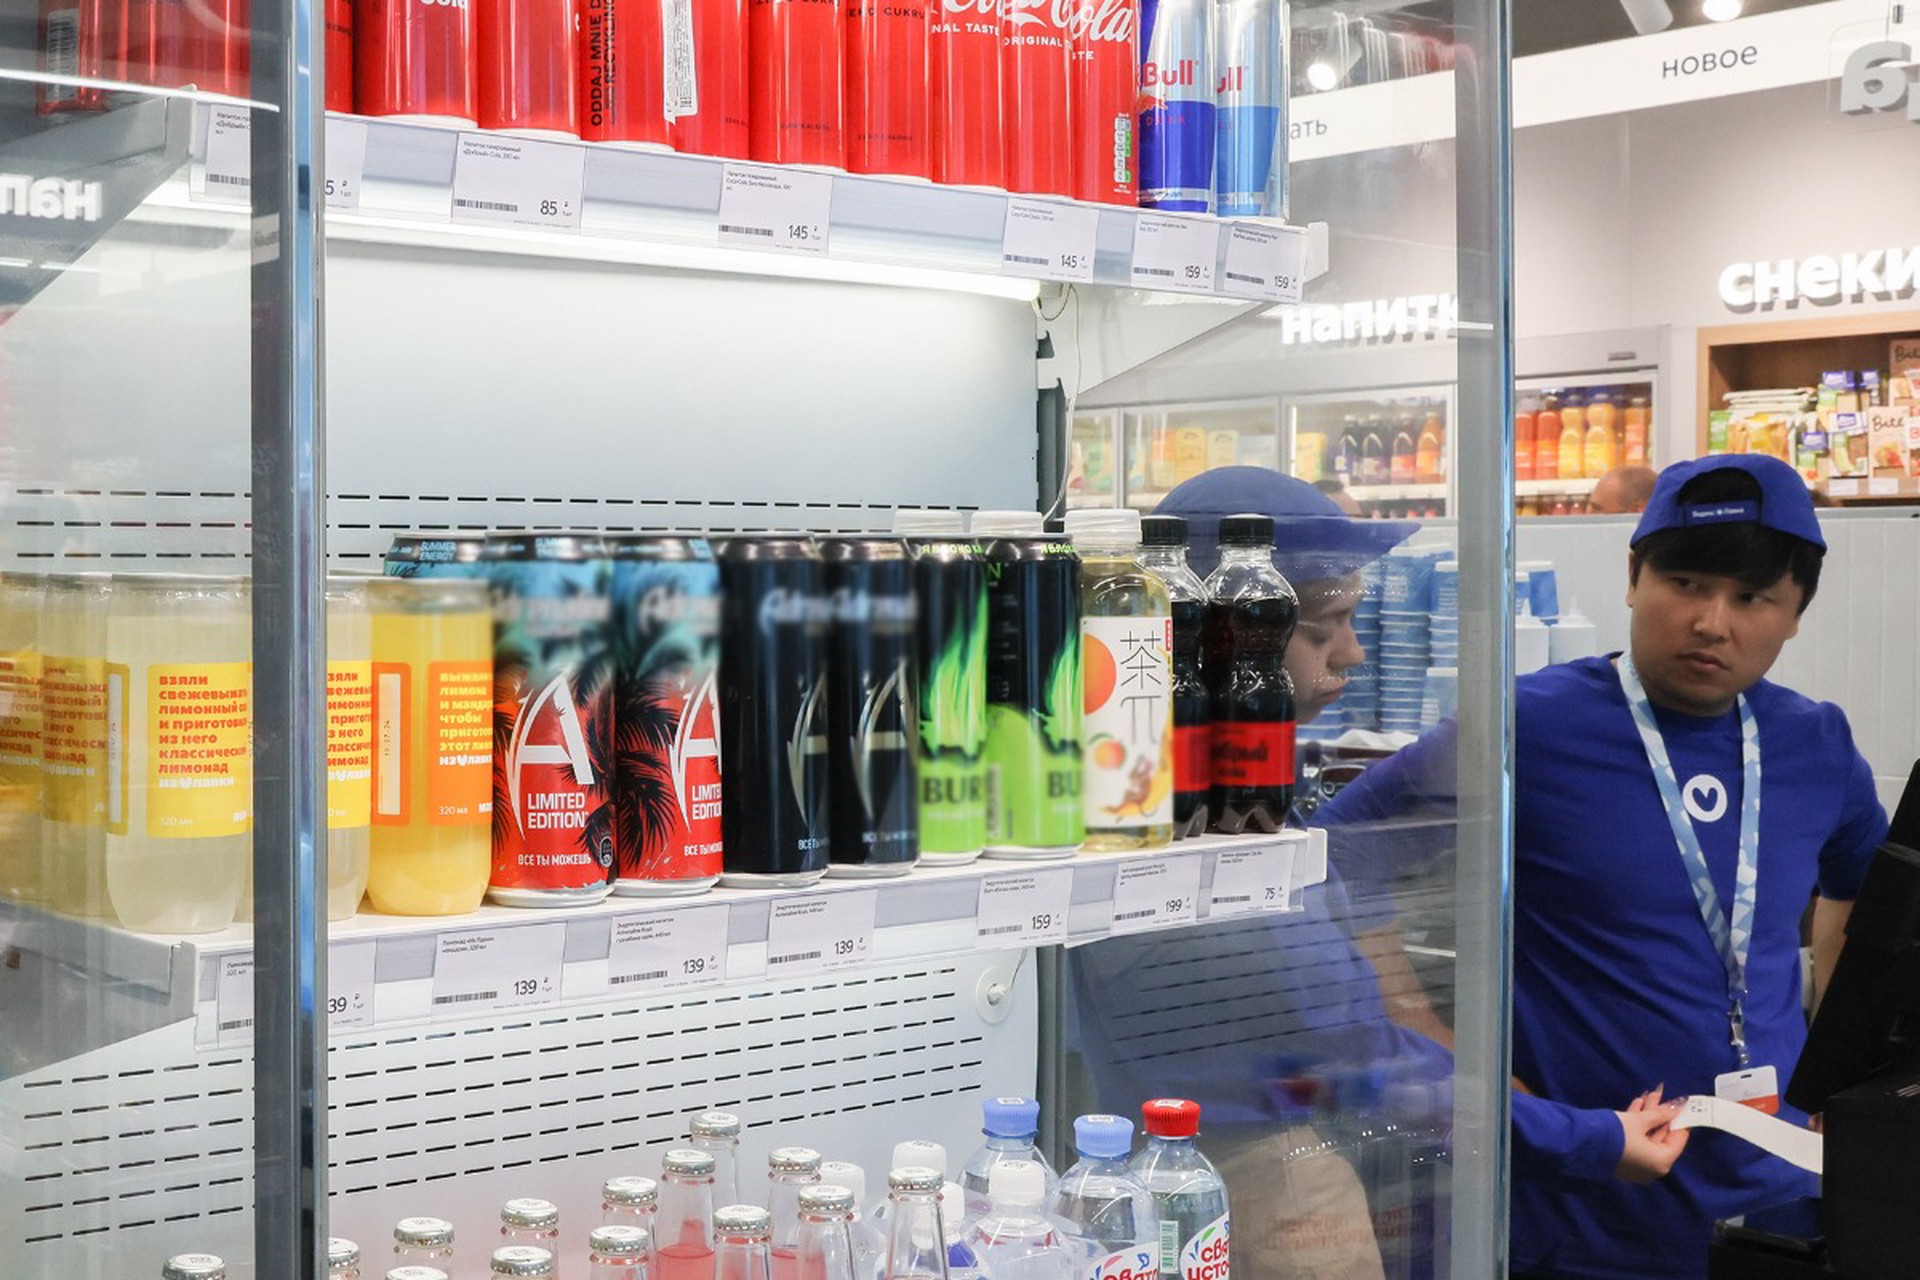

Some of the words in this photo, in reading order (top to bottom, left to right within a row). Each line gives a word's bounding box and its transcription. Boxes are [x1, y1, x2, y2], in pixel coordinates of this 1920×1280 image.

[591, 15, 602, 60] MNIE
[1662, 45, 1758, 79] новое
[591, 66, 602, 126] ODDAJ
[1289, 119, 1328, 140] ать
[324, 180, 335, 195] 5
[540, 200, 557, 215] 85
[788, 225, 808, 239] 145
[1061, 254, 1077, 268] 145
[1185, 265, 1200, 279] 159
[1718, 245, 1920, 306] снеки
[1274, 275, 1289, 289] 159
[159, 676, 208, 686] взяли
[326, 672, 358, 682] зяли
[158, 701, 237, 714] лимонный
[440, 701, 449, 710] и
[159, 720, 169, 729] и
[440, 713, 482, 723] чтобы
[159, 735, 178, 744] из
[182, 734, 217, 744] него
[327, 728, 336, 738] з
[338, 727, 364, 738] него
[439, 742, 471, 751] этот
[158, 763, 229, 774] лимонад
[326, 756, 369, 767] имонад
[692, 783, 722, 801] LIMITE
[528, 793, 585, 810] LIMITED
[439, 807, 455, 816] 320
[692, 801, 722, 820] EDITIO
[528, 811, 585, 829] EDITION
[684, 845, 698, 856] ВСЕ
[518, 854, 534, 865] ВСЕ
[537, 854, 550, 865] ТЫ
[552, 853, 592, 865] МОЖЕШЬ
[1265, 888, 1275, 900] 75
[1165, 899, 1183, 912] 199
[1032, 914, 1051, 930] 159
[835, 939, 854, 955] 139
[683, 958, 704, 974] 139
[514, 980, 537, 996] 139
[328, 997, 347, 1014] 39
